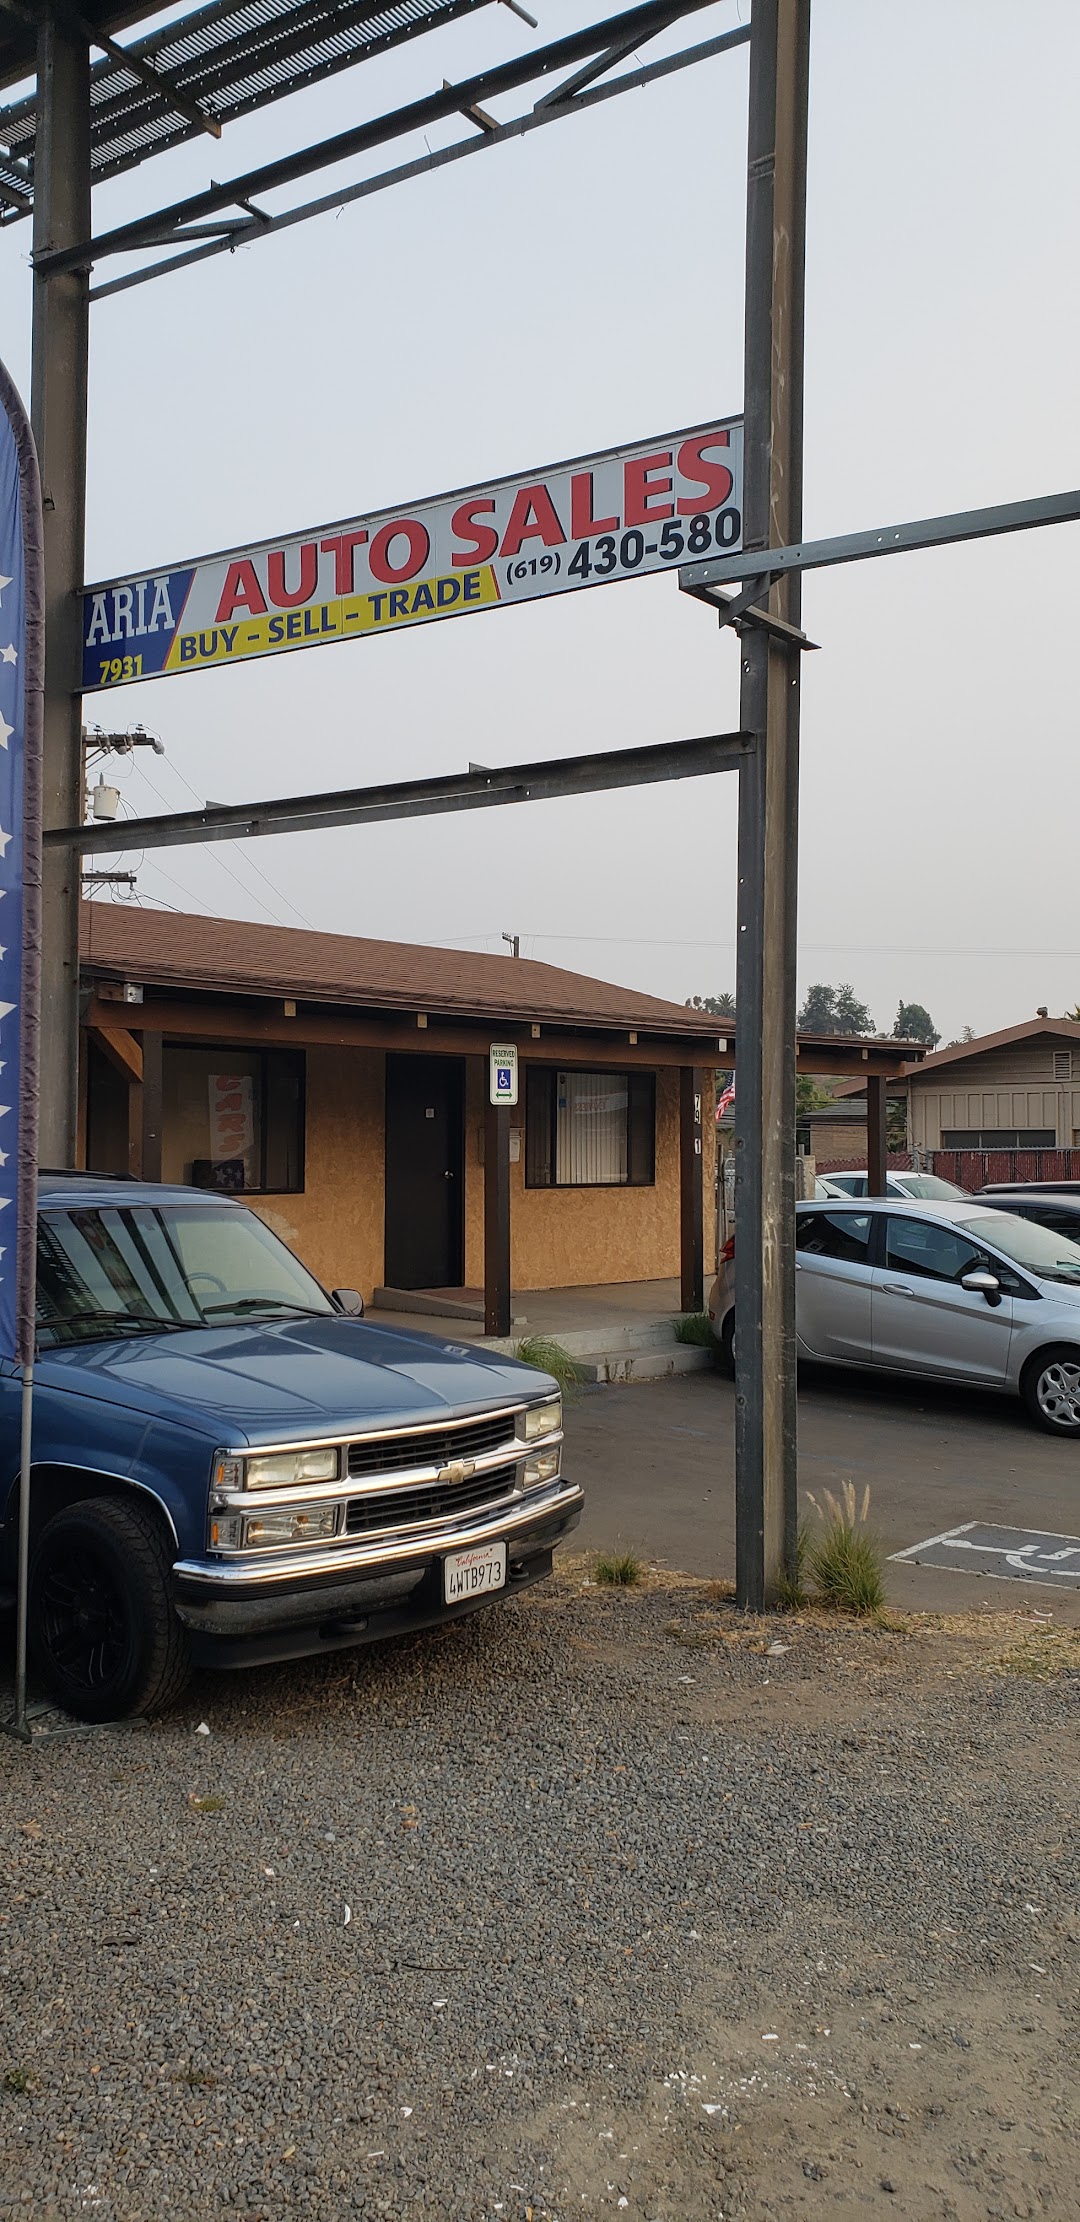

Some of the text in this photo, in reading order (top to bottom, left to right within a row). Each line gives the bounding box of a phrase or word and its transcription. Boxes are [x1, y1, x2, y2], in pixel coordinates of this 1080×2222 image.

[214, 430, 734, 623] AUTO SALES
[506, 507, 741, 585] (619) 430-580
[86, 576, 175, 647] ARIA
[180, 625, 240, 662] BUY
[268, 606, 337, 643] SELL
[367, 572, 481, 621] TRADE
[99, 654, 144, 684] 7931
[492, 1049, 515, 1058] RESERVED
[493, 1059, 514, 1067] PARKING
[455, 1551, 493, 1567] California
[449, 1561, 501, 1594] 4WTB973
